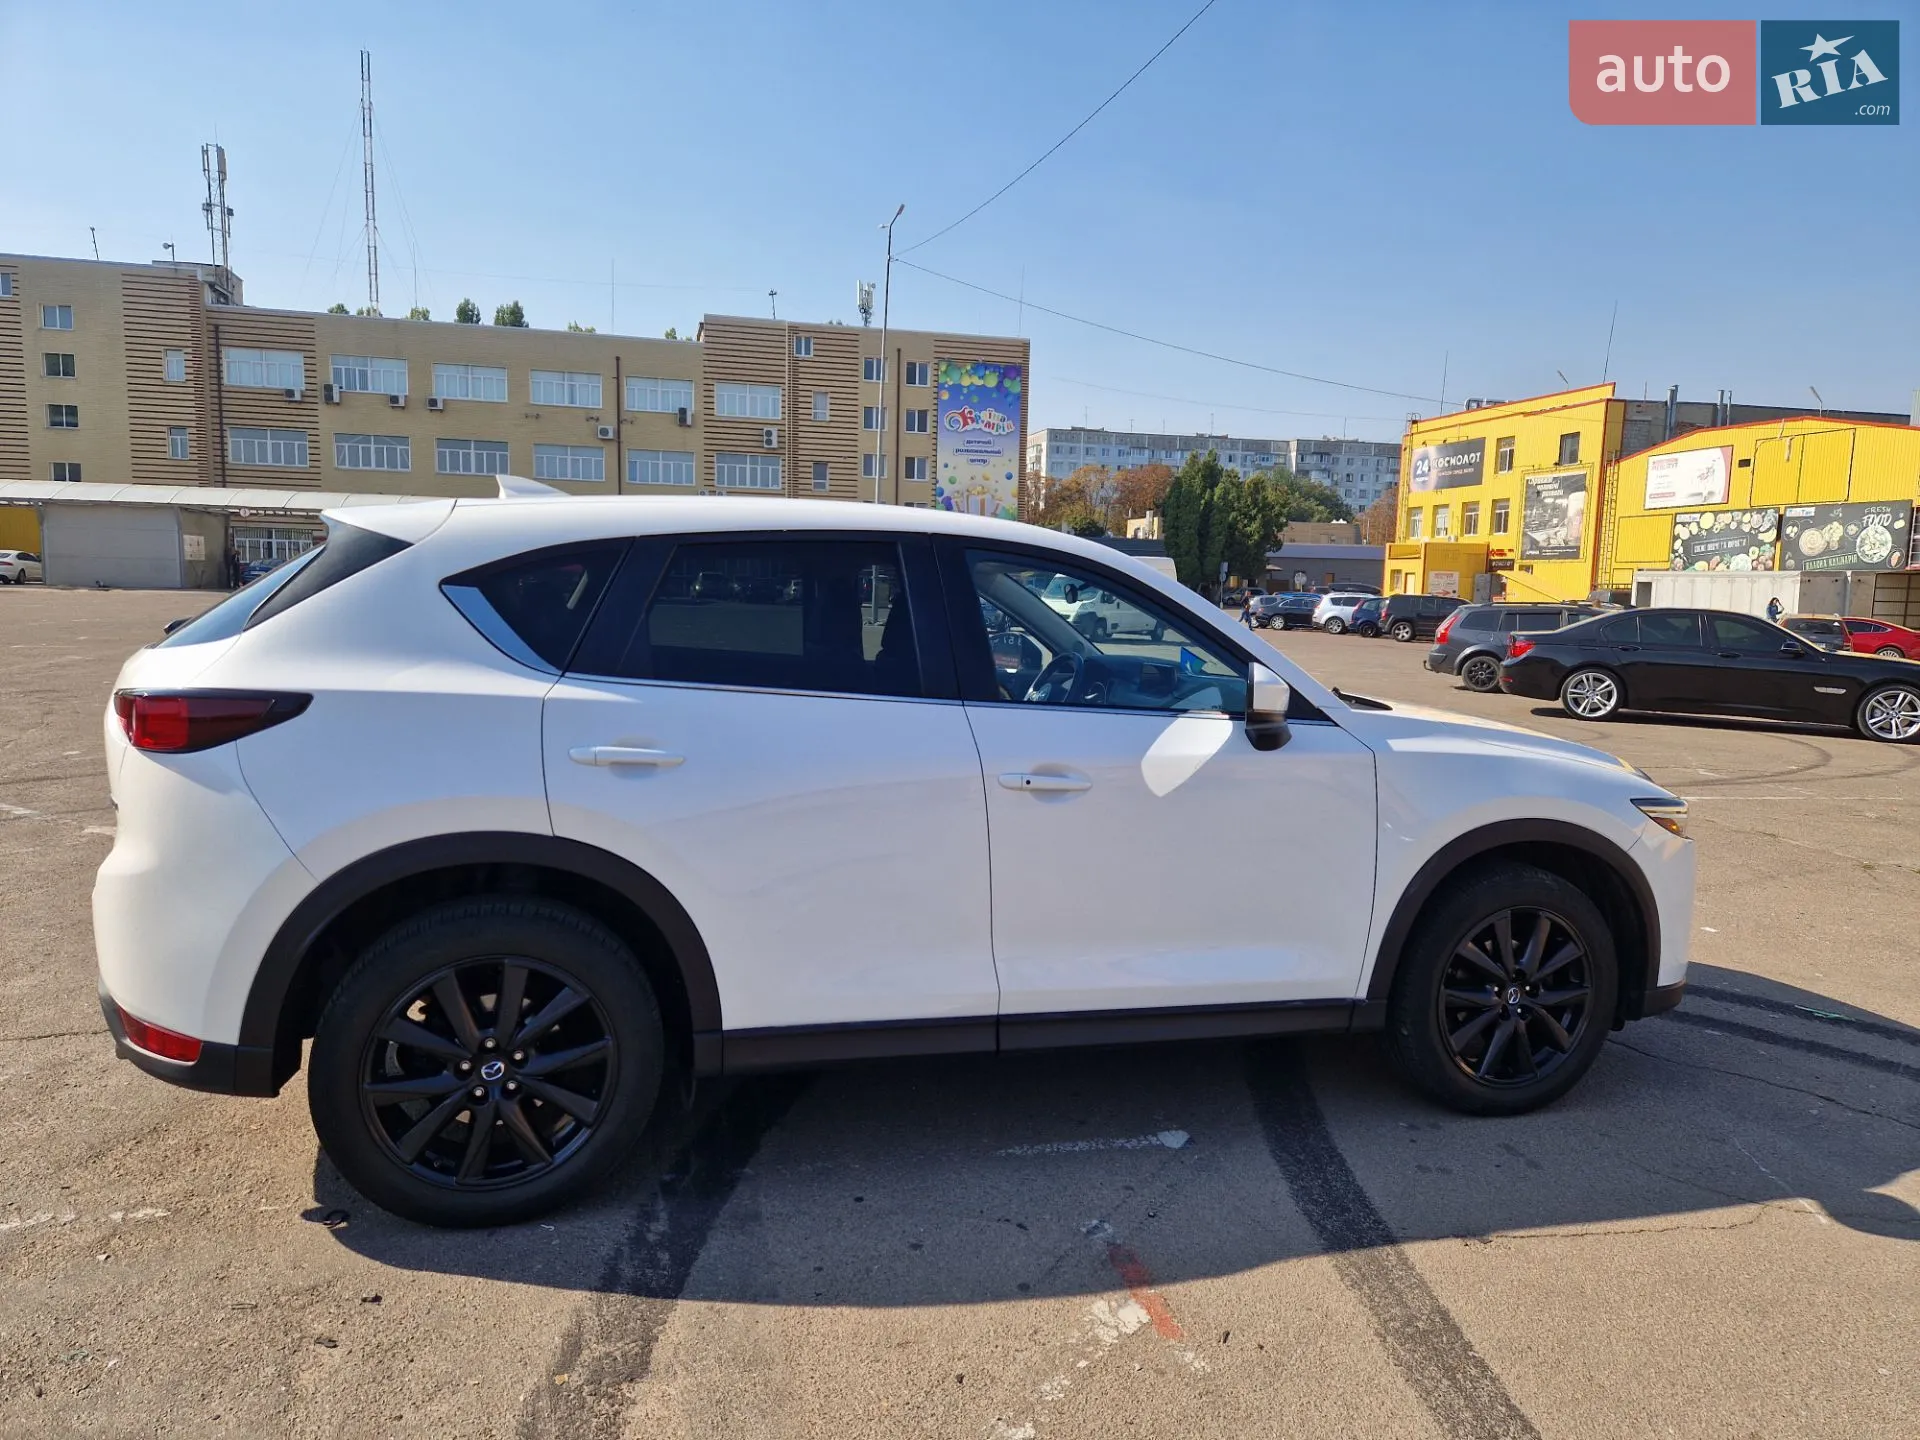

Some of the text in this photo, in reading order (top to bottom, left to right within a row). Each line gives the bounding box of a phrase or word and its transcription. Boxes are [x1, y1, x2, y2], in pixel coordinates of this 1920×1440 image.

[1416, 459, 1429, 475] 24
[1864, 506, 1891, 514] FRESH
[1861, 513, 1892, 527] FOOD
